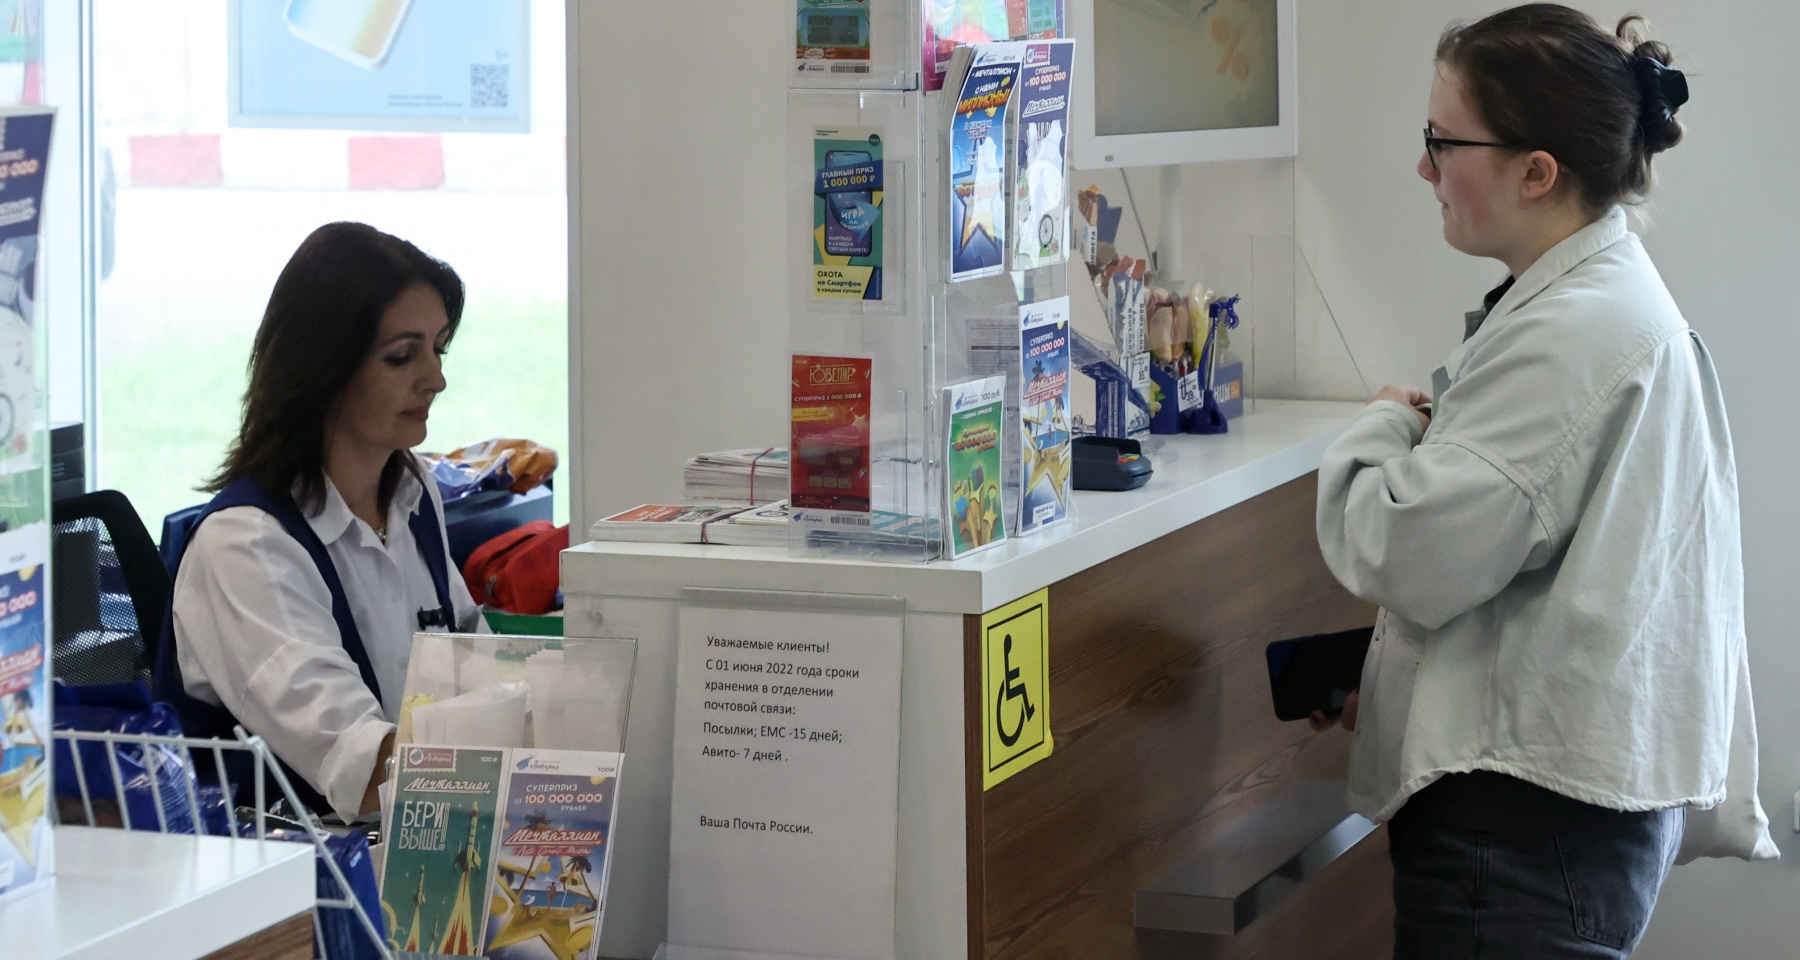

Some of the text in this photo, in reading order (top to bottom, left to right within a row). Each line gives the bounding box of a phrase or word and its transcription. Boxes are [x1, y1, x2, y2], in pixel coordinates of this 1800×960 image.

[1029, 77, 1040, 87] 100
[1040, 74, 1053, 85] 000
[1054, 72, 1066, 82] 000
[822, 166, 874, 179] ГЛАВНЫЙ ПРИЗ
[823, 180, 829, 188] 1
[831, 177, 848, 187] 000
[850, 175, 868, 185] 000
[841, 207, 865, 219] ИГРА
[827, 280, 862, 288] Смартфон
[1029, 347, 1040, 358] 100
[1041, 342, 1052, 354] 000
[1053, 337, 1065, 348] 000
[809, 364, 857, 383] ЮВЕЛИР
[982, 393, 990, 401] 100
[707, 636, 829, 653] Уважаемые клиенты!
[706, 659, 859, 679] С 01 июня 2022 года сроки
[705, 682, 833, 697] хранения в отделении
[705, 701, 795, 714] почтовой связи:
[704, 722, 842, 743] Посылки; ЕМС -15 дней;
[702, 746, 739, 758] Авито-
[744, 748, 750, 758] 7
[753, 750, 781, 762] дней
[403, 777, 491, 794] Мечталлион
[526, 783, 578, 793] СУПЕРПРИЗ
[525, 794, 545, 804] 100
[548, 794, 574, 804] 000
[576, 793, 602, 803] 000
[402, 801, 444, 828] БЕРИ
[561, 804, 587, 812] РУБЛЕЙ
[700, 816, 812, 834] Ваша Почта России.
[504, 829, 602, 846] Мечталлион
